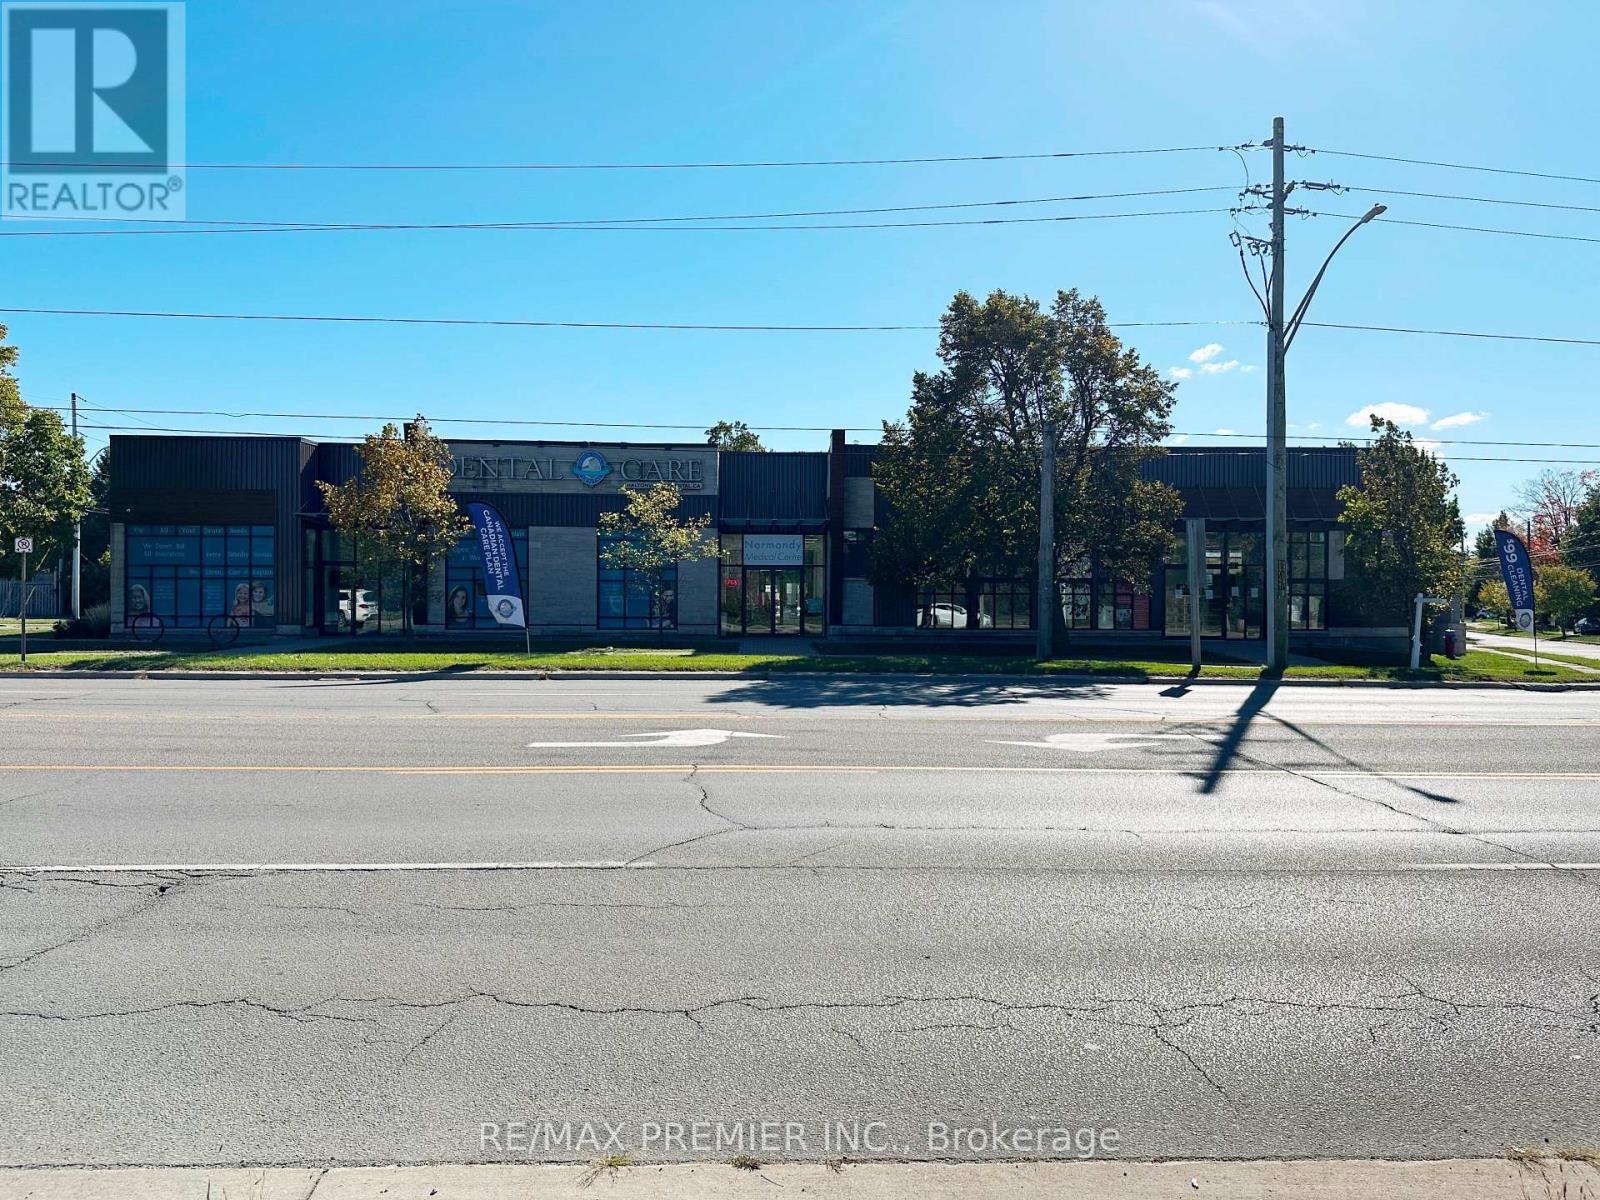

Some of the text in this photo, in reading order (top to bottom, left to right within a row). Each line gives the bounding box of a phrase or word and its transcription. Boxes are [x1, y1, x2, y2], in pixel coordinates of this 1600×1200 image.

[620, 458, 703, 481] CARE
[480, 528, 494, 574] CARE PLAN
[483, 509, 504, 591] CANADIAN DENTAL
[494, 520, 510, 576] WE ACCEPT THE
[745, 540, 802, 551] Normandy
[745, 552, 777, 561] Medical
[1507, 564, 1523, 607] CLEANING
[1516, 567, 1529, 601] DENTAL
